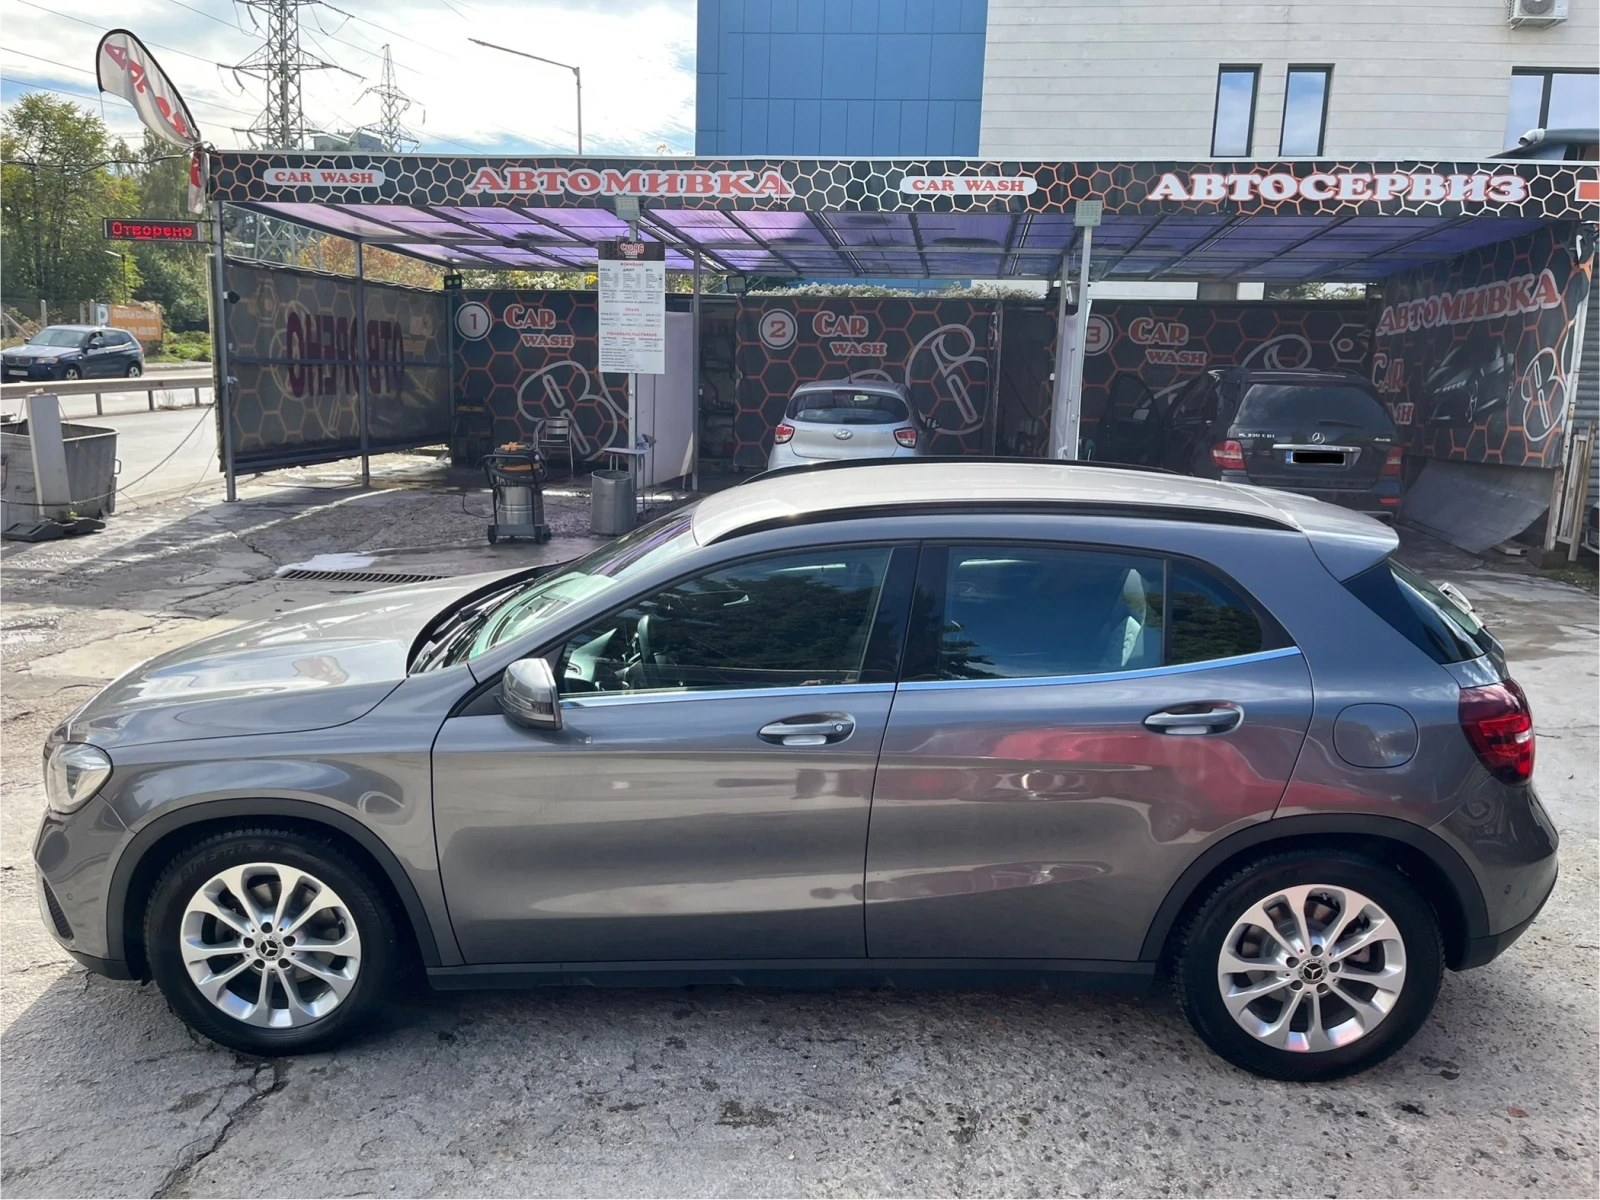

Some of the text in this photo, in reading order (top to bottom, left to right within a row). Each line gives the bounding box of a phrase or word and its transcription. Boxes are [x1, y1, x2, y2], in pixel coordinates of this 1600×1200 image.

[273, 171, 373, 184] CAR WASH
[468, 168, 793, 198] АВТОМИВКА
[911, 179, 1025, 192] CAR WASH
[1147, 173, 1529, 201] АВТОСЕРВИЗ
[112, 221, 193, 238] Отворено
[1375, 268, 1561, 336] АВТОМИВКА
[469, 313, 478, 330] 1
[769, 320, 787, 339] 2
[521, 334, 574, 347] WASH
[1086, 326, 1101, 344] 3
[829, 341, 887, 357] WASH
[1145, 349, 1207, 365] WASH
